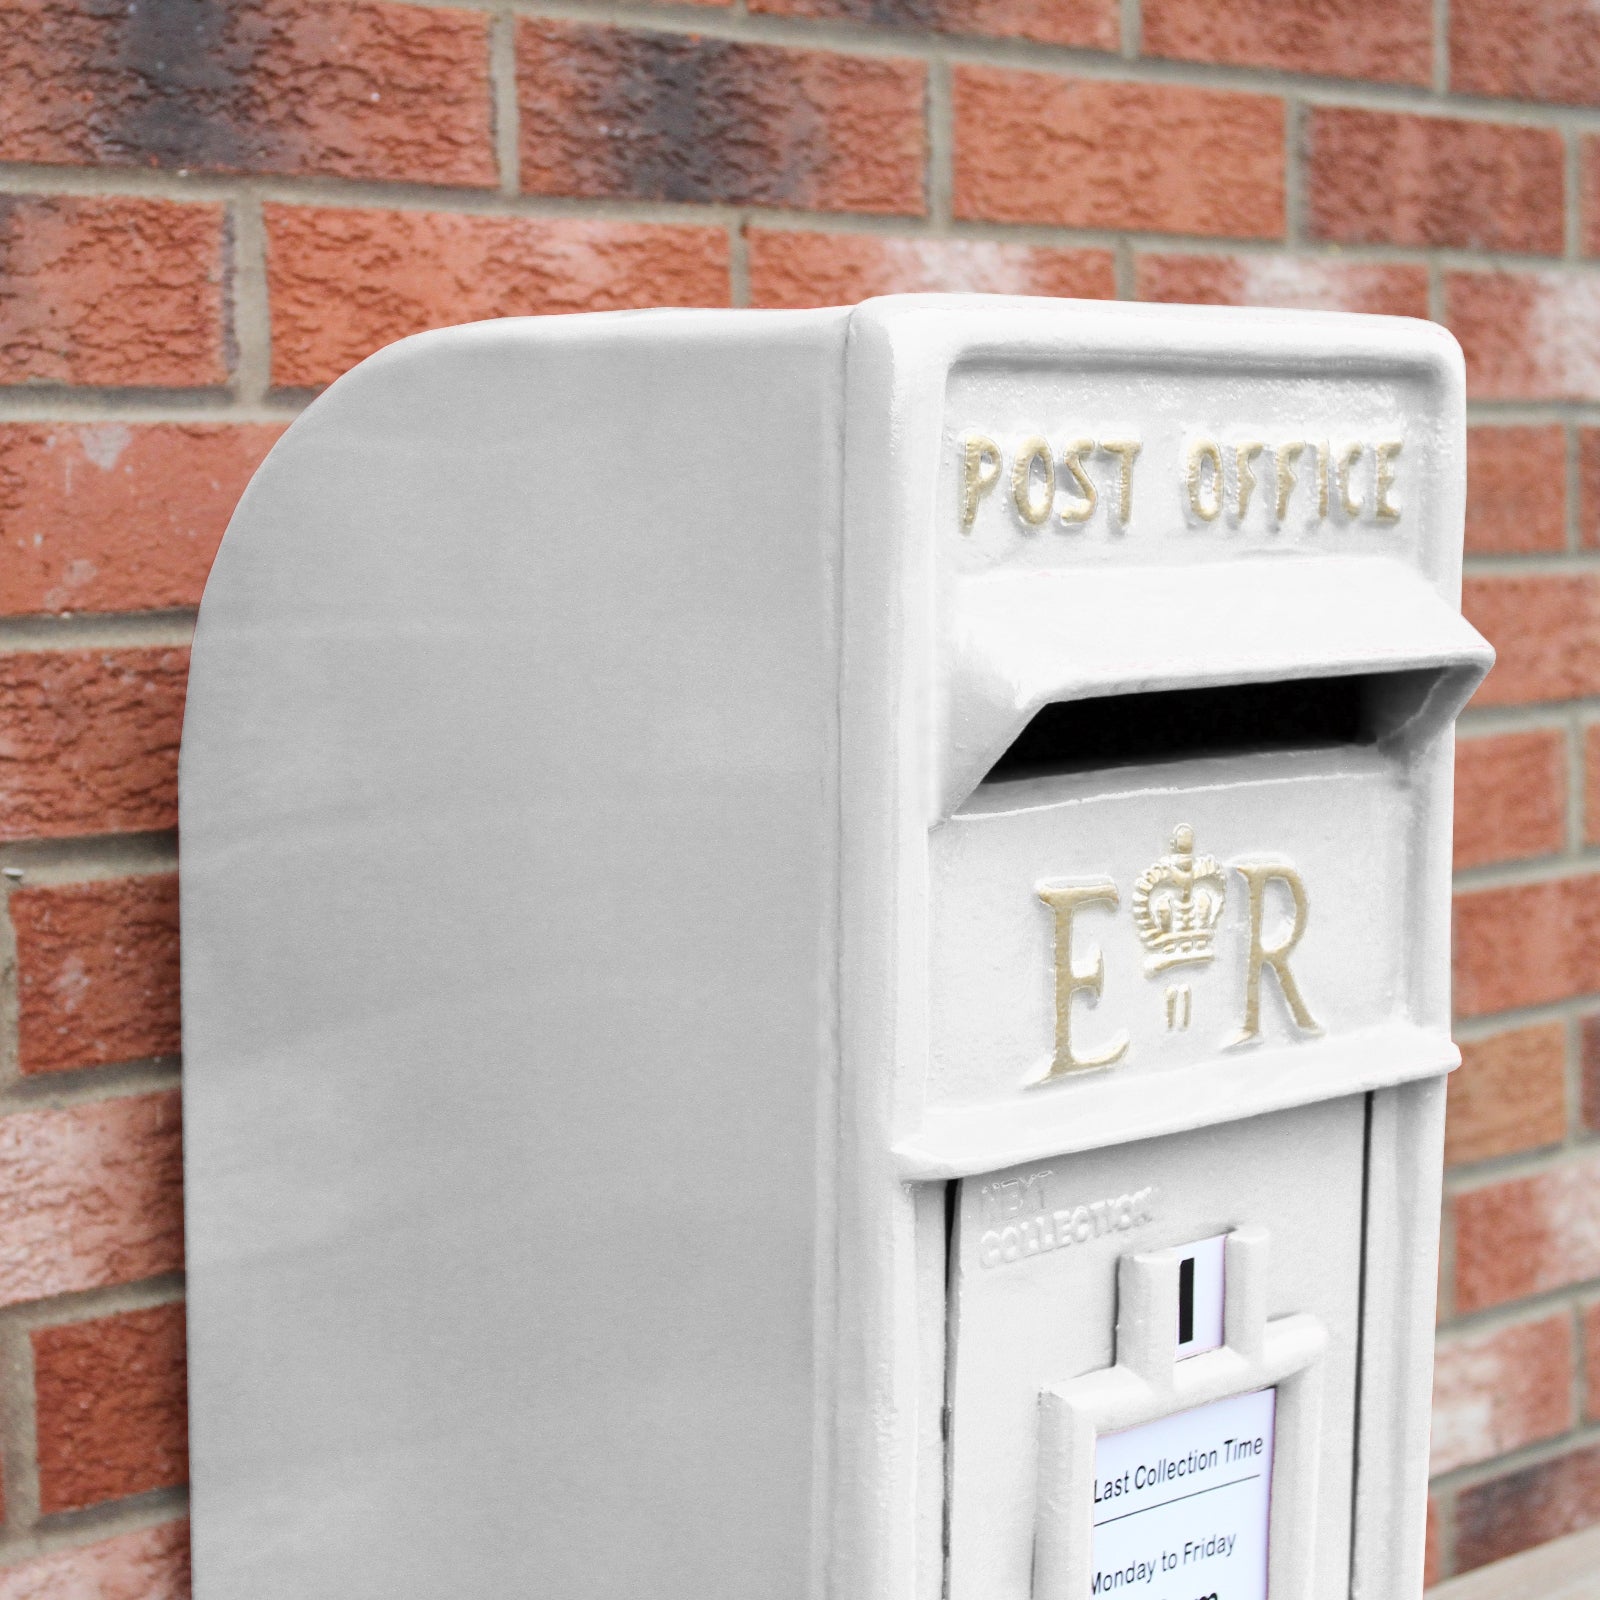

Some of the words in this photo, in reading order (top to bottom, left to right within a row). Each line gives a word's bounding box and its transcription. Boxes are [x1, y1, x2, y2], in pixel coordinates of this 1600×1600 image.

[961, 434, 1141, 532] POST
[1186, 437, 1403, 528] OFFICE
[1025, 876, 1130, 1089] E
[1225, 852, 1325, 1051] R
[1094, 1470, 1130, 1504] Last
[1134, 1448, 1218, 1491] Collection
[1224, 1437, 1264, 1463] Time
[1161, 1550, 1178, 1572] to
[1183, 1533, 1237, 1565] Friday
